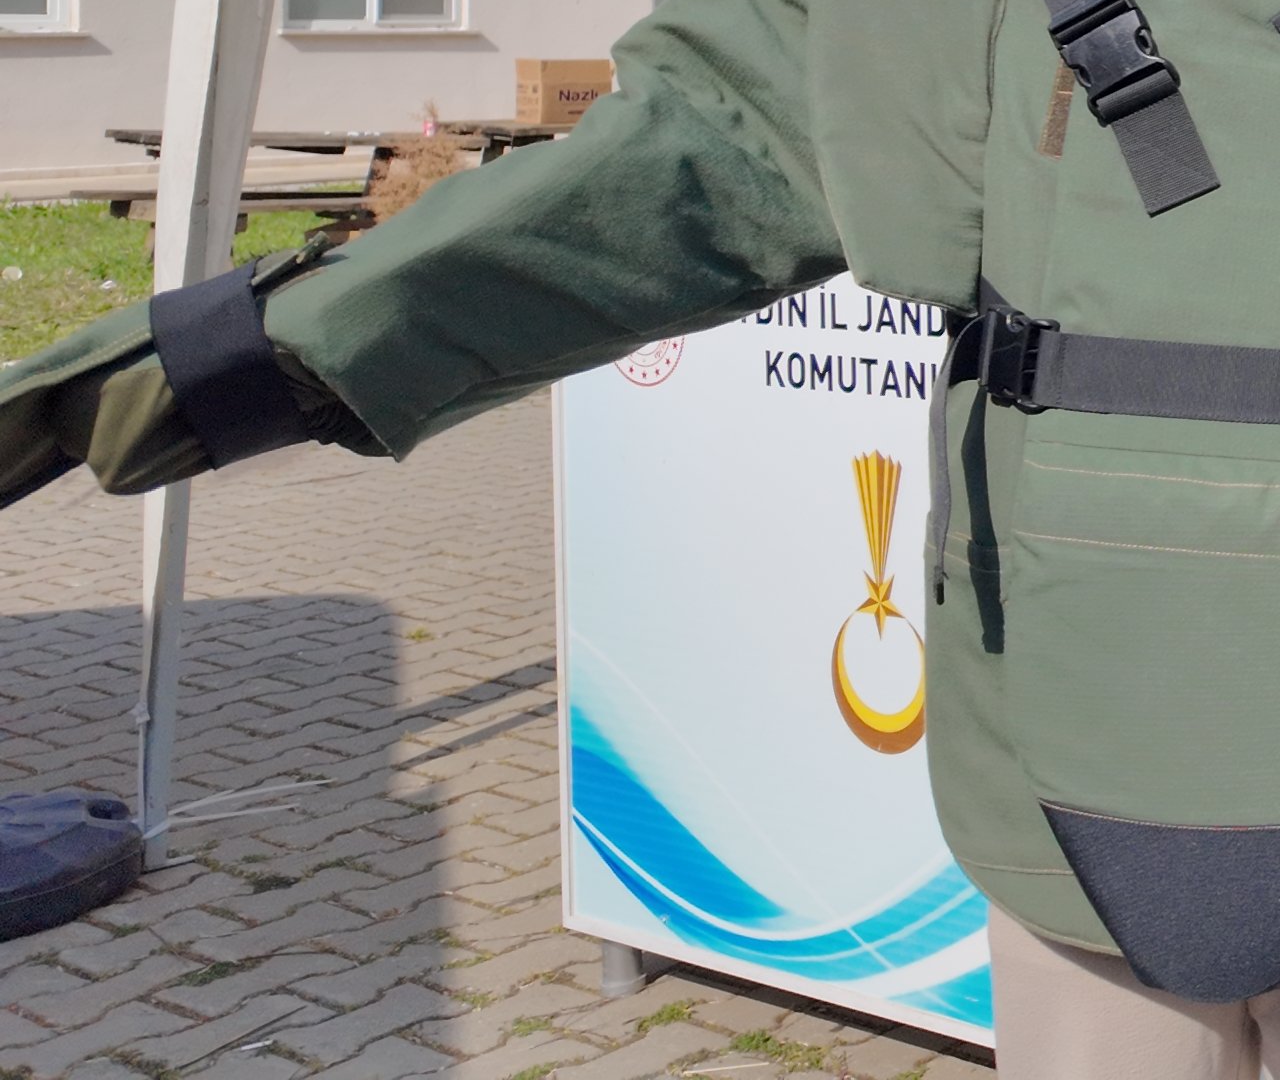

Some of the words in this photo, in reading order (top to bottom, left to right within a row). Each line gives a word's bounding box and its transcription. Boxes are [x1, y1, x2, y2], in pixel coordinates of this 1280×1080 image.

[820, 285, 848, 331] İL
[857, 294, 946, 338] JAND
[765, 349, 938, 400] KOMUTAN
